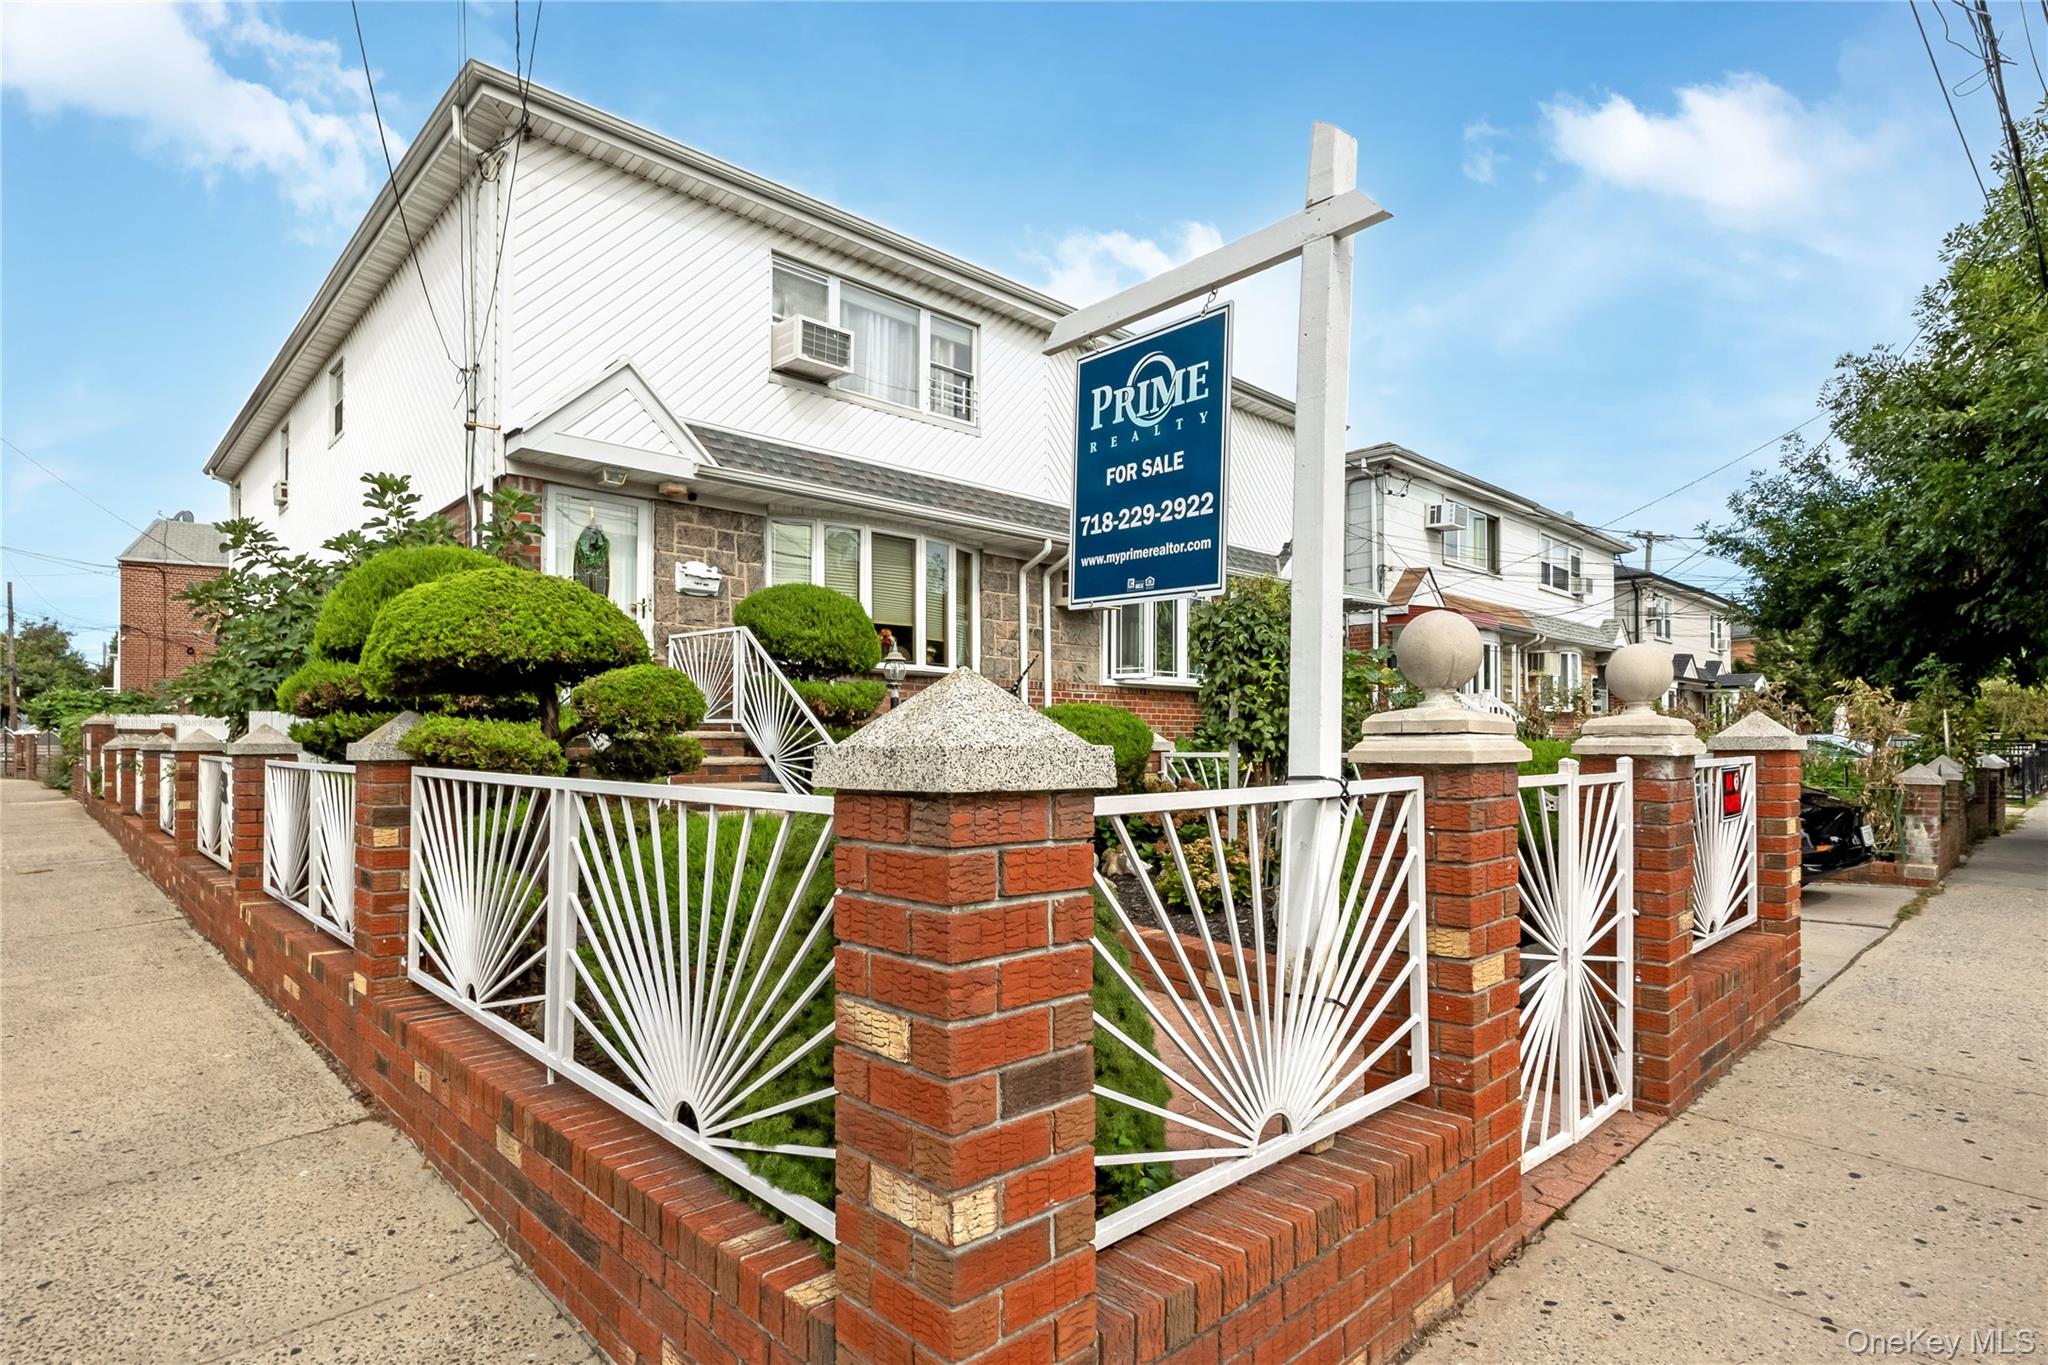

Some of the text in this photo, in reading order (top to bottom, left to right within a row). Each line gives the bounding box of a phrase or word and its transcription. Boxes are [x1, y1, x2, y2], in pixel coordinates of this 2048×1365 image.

[1090, 360, 1209, 431] PRIME
[1089, 410, 1208, 454] REALTY
[1106, 450, 1185, 487] FOR SALE
[1080, 491, 1214, 537] 718-229-2922
[1080, 538, 1212, 568] www.myprimerealtor.com
